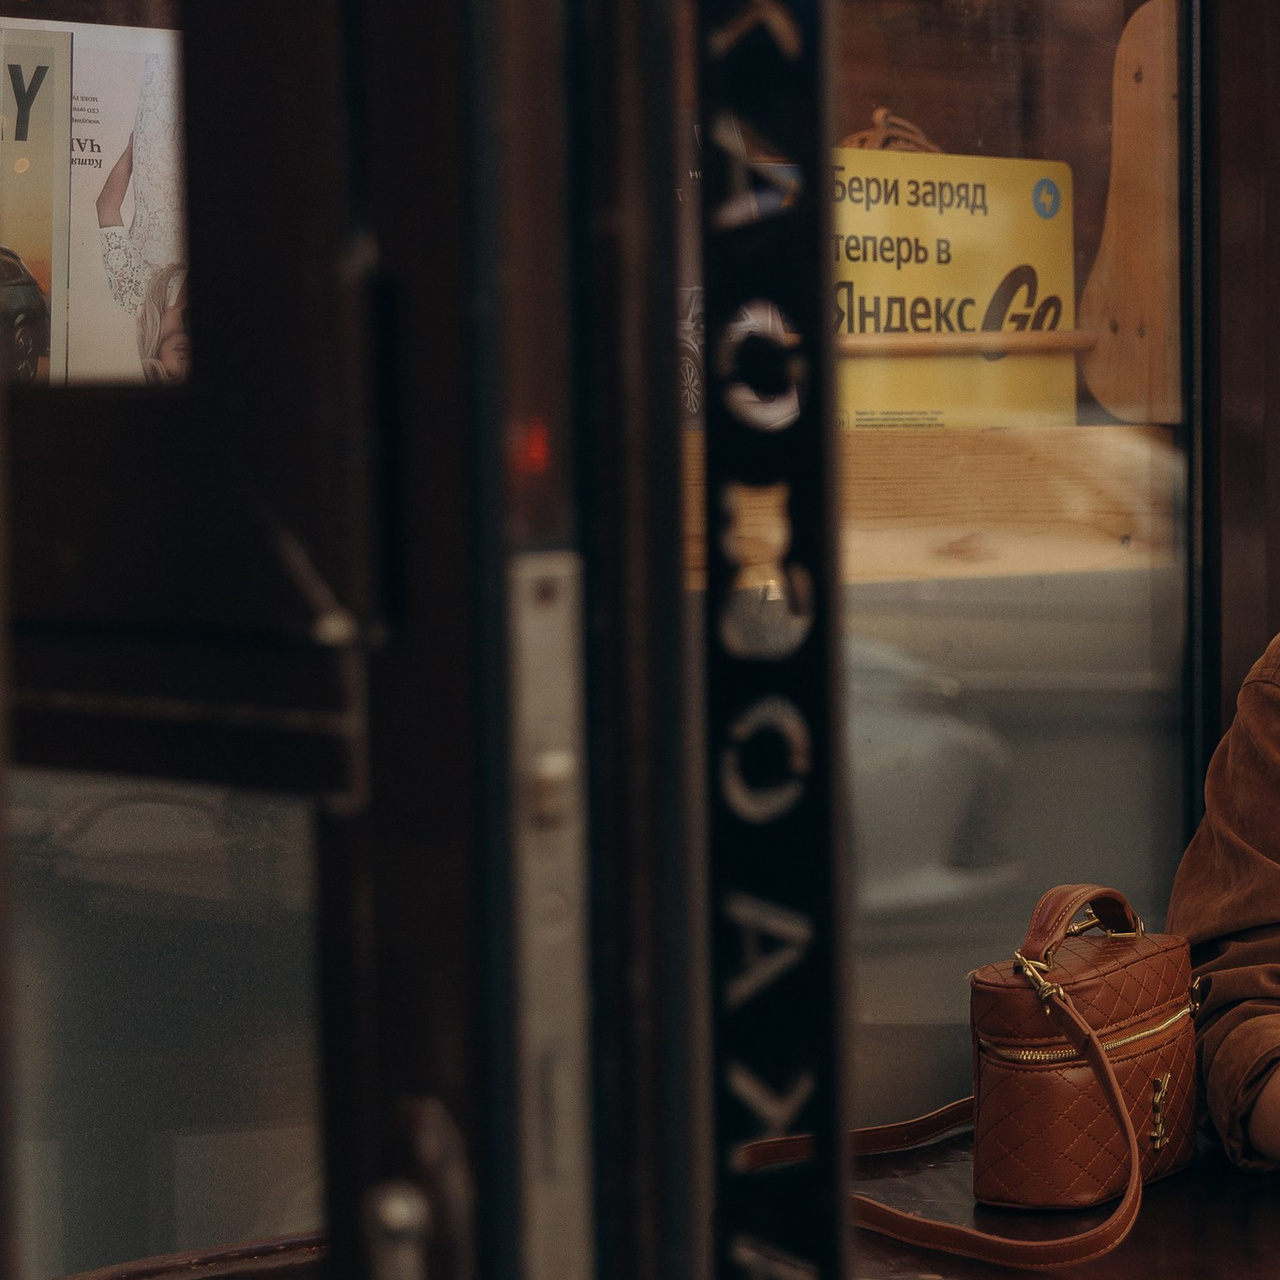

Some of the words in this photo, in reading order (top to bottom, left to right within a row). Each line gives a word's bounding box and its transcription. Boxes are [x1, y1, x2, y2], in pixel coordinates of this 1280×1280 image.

[2, 63, 50, 141] Y
[831, 165, 899, 212] Бери
[906, 179, 988, 216] заряд
[833, 233, 929, 271] теперь
[936, 238, 952, 265] в
[832, 281, 976, 335] Яндекс
[979, 264, 1063, 362] Go
